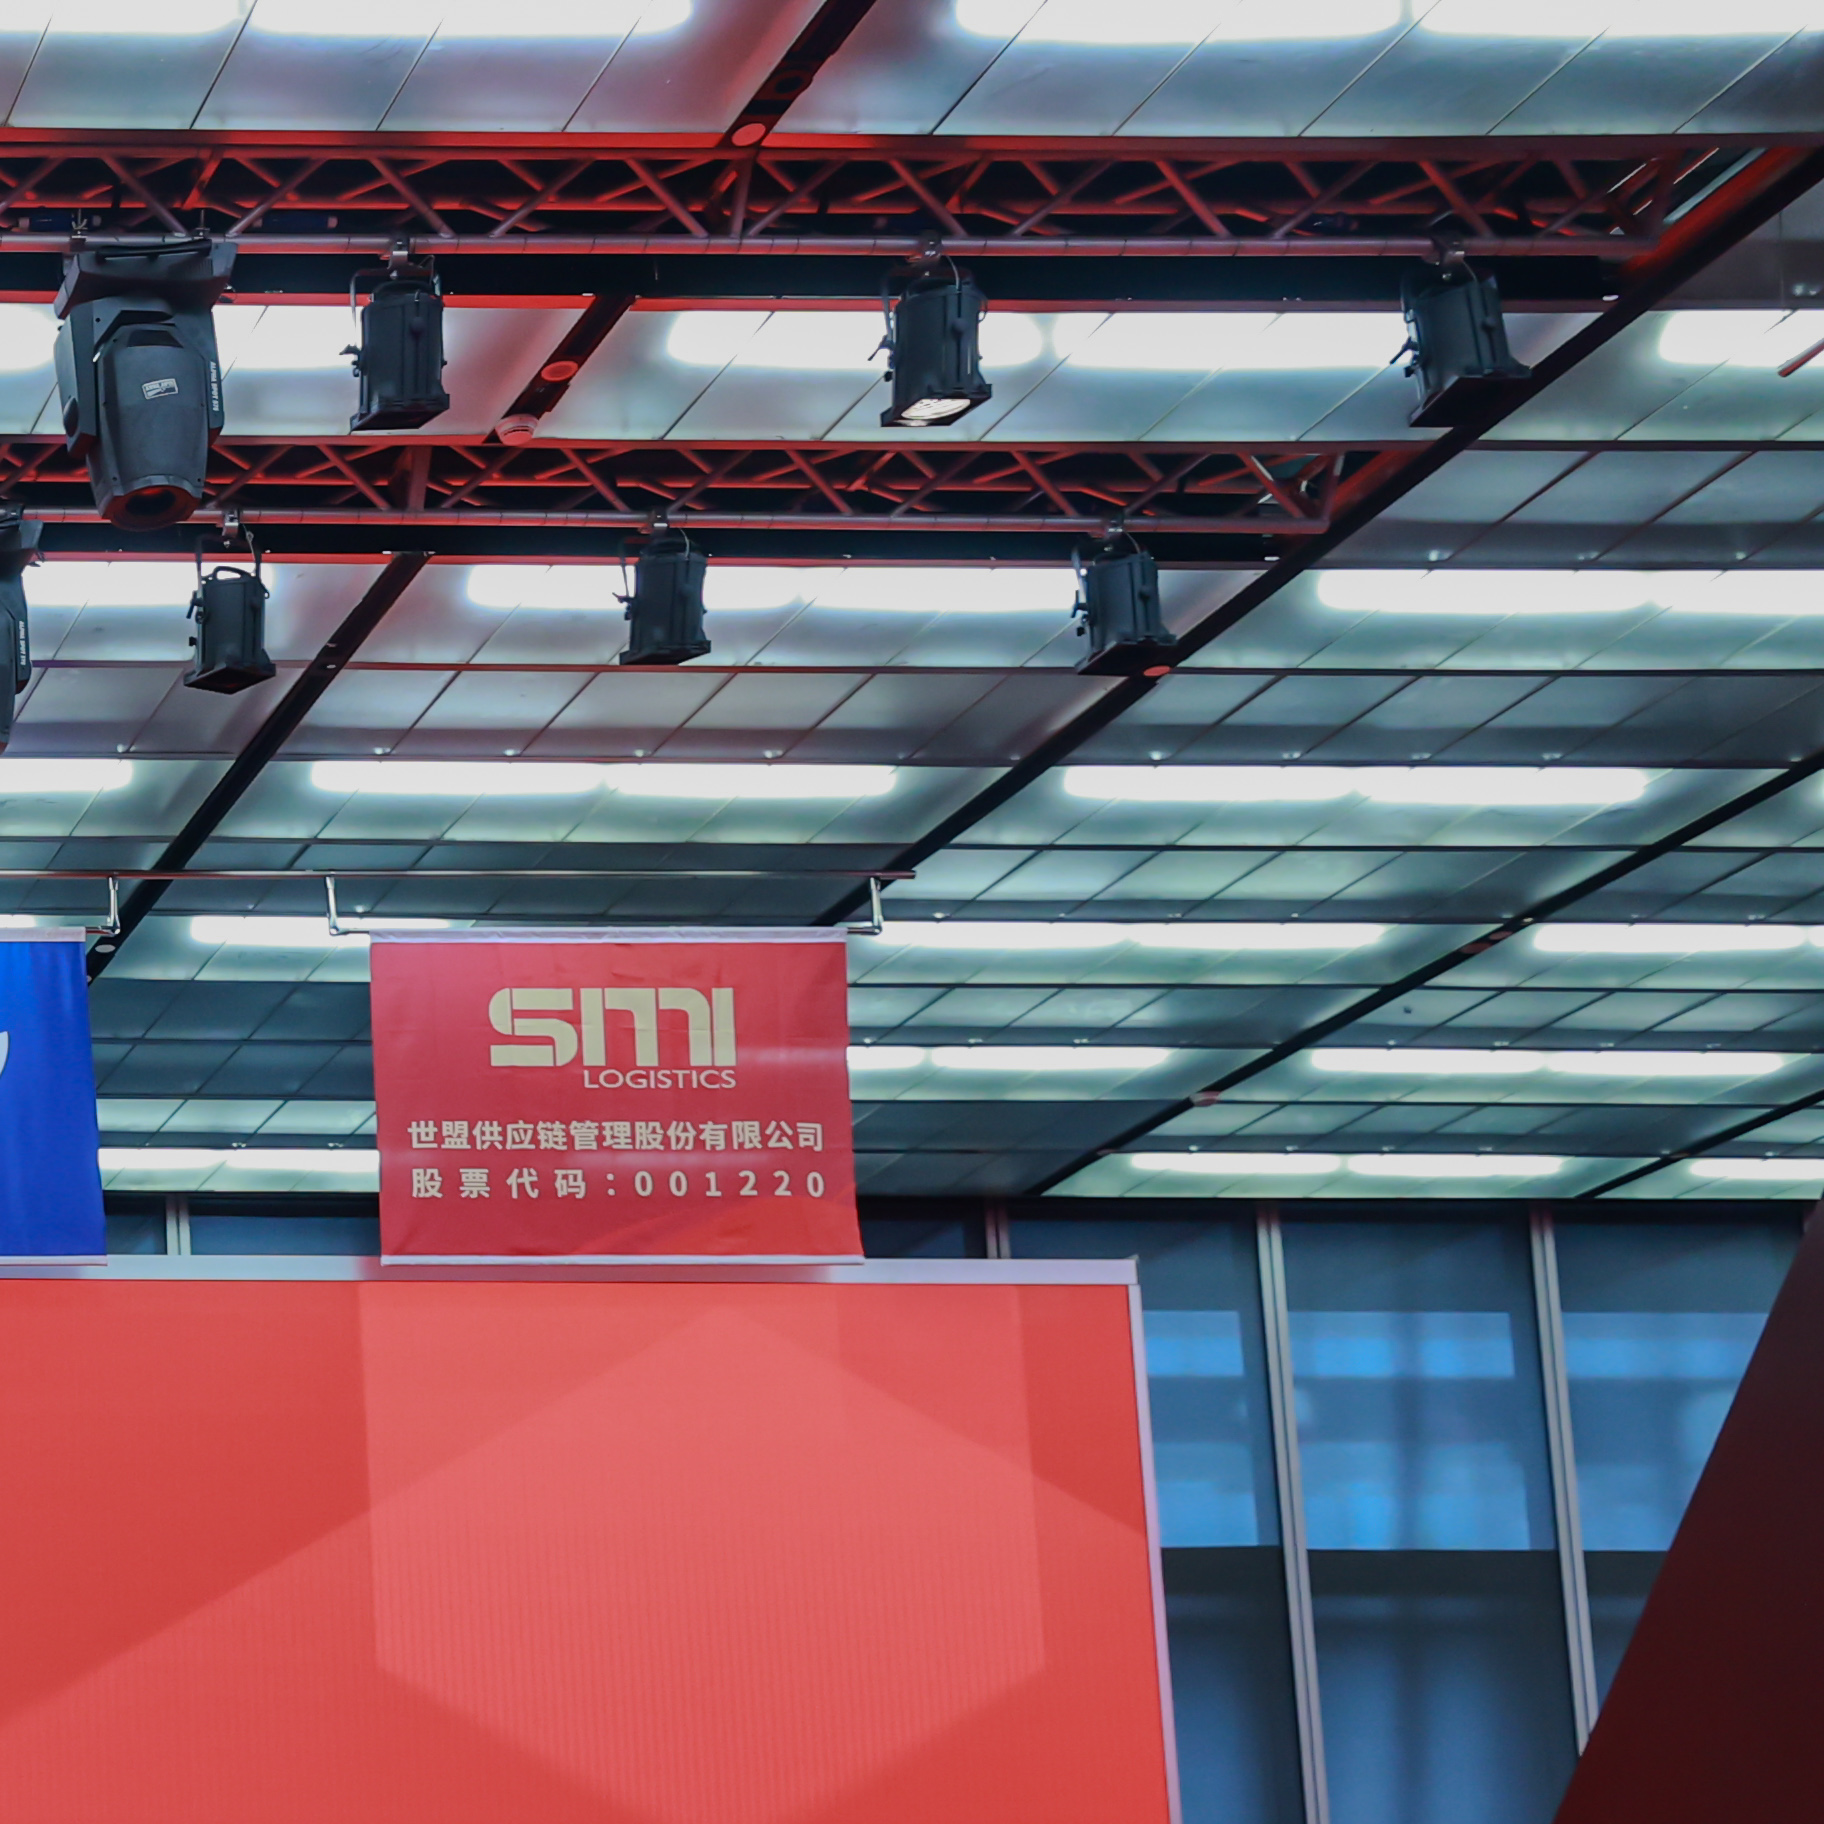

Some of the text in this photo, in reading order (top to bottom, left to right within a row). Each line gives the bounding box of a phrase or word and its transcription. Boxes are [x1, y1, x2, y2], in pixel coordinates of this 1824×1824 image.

[583, 1069, 737, 1089] LOGISTICS
[407, 1119, 824, 1152] 世盟供应链管理股份有限公司
